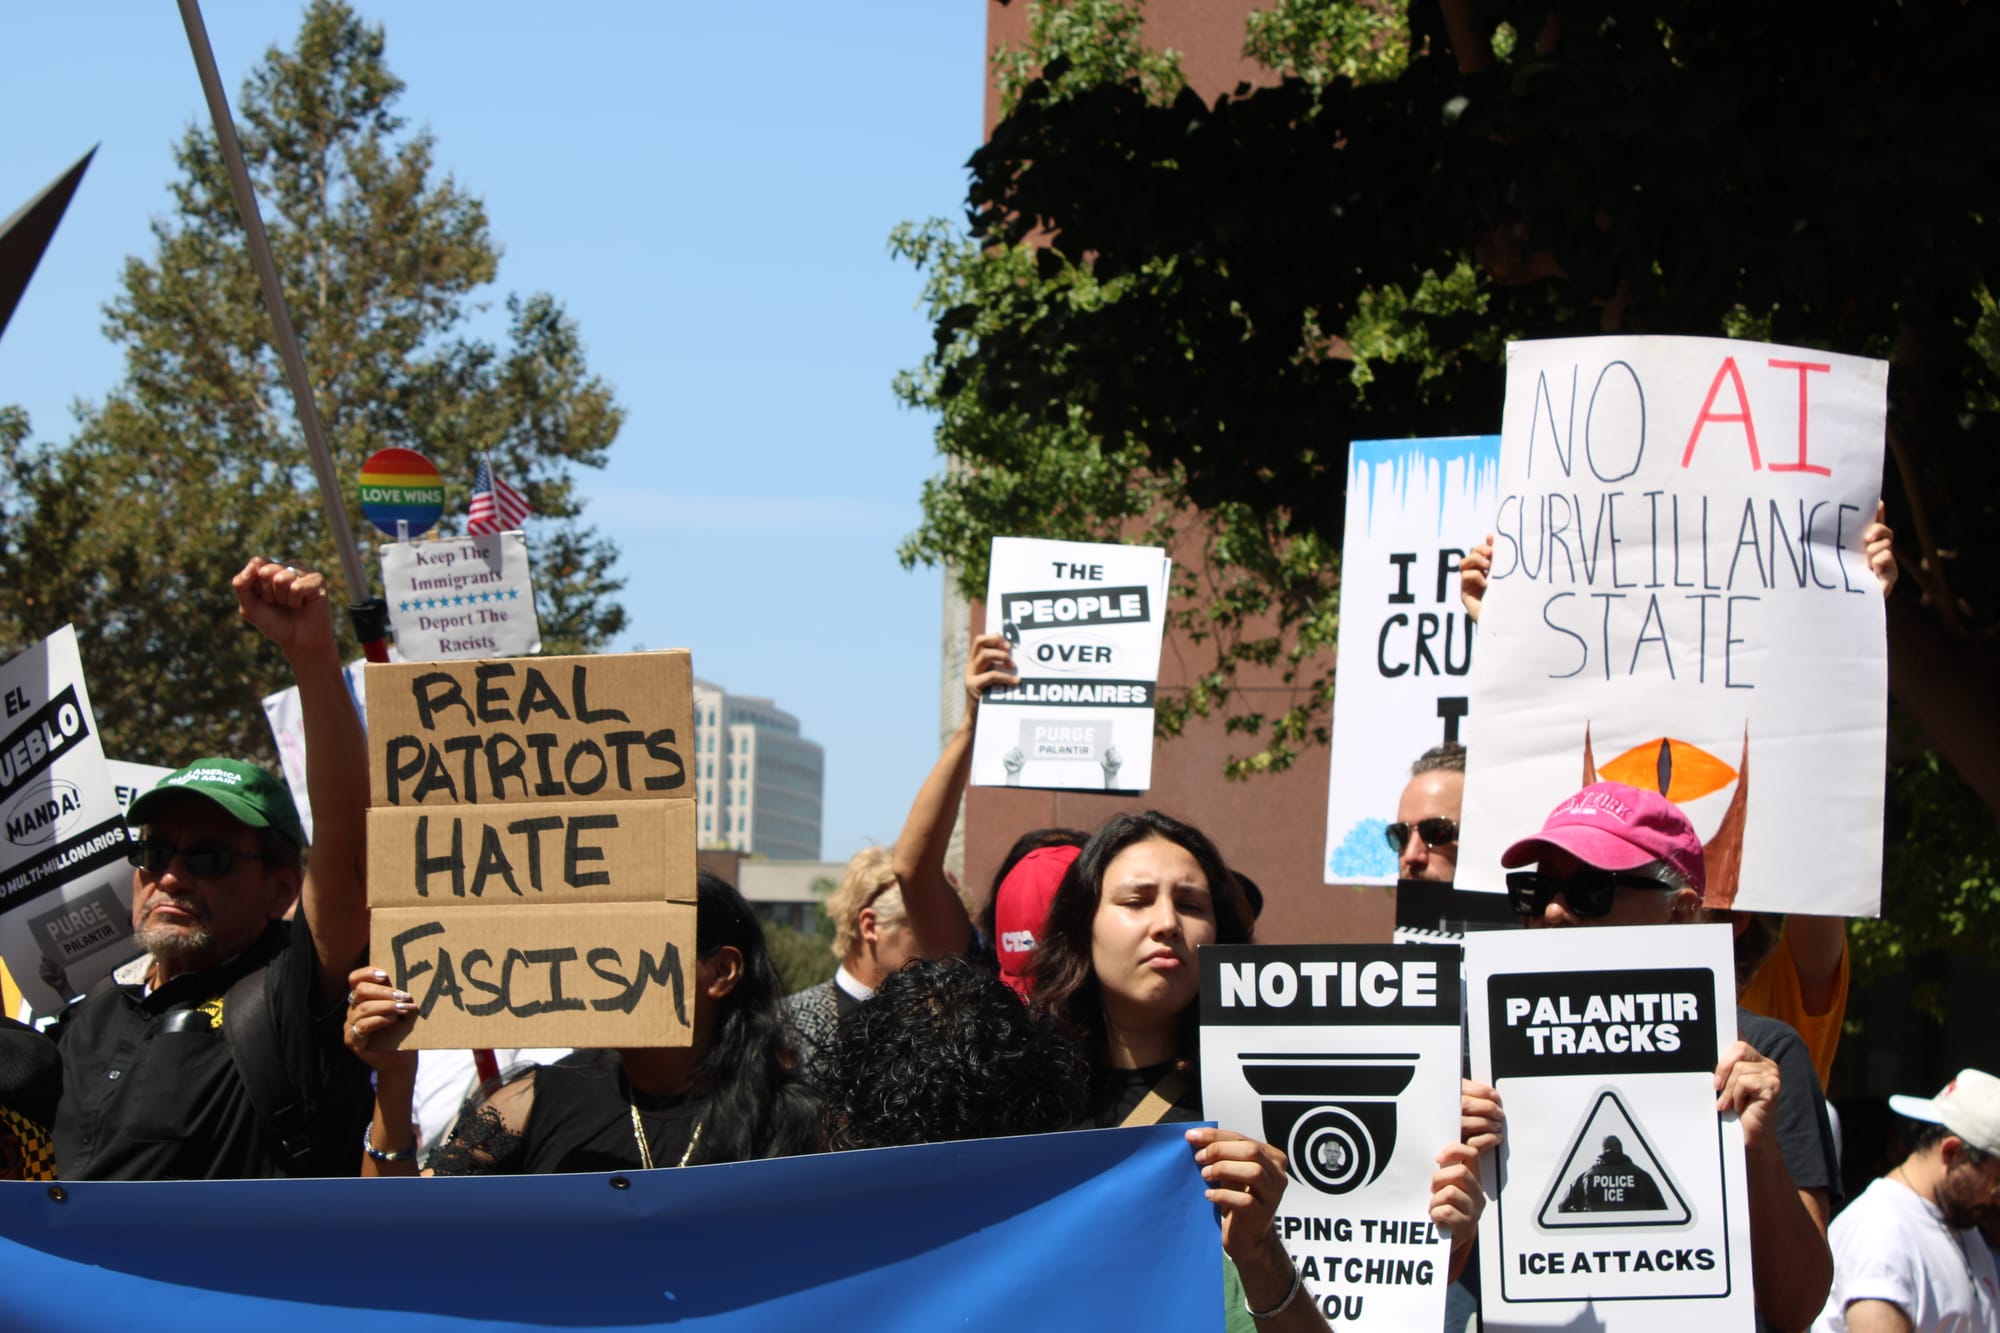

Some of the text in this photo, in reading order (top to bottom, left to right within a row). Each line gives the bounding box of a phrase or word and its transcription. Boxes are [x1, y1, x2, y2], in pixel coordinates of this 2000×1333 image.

[1527, 355, 1832, 482] NO AI
[362, 488, 442, 504] LOVE WINS
[416, 546, 490, 568] Keep The
[1491, 490, 1865, 594] SURVEILLANCE
[410, 569, 503, 591] Immigrants
[1052, 561, 1104, 581] THE
[1388, 548, 1473, 604] I P
[418, 607, 508, 632] Deport The
[1009, 594, 1142, 624] PEOPLE
[438, 635, 496, 654] Racists
[1037, 643, 1113, 664] OVER
[1377, 612, 1478, 679] CRU
[1543, 592, 1761, 689] STATE
[4, 686, 31, 719] EL
[411, 662, 631, 731] REAL
[0, 703, 80, 788] UEBLO
[1034, 725, 1097, 742] PURGE
[1039, 744, 1089, 755] PALANTIR
[192, 767, 243, 782] AMERICA
[385, 727, 687, 805] PATRIOTS
[6, 788, 82, 843] MANDA!
[8, 827, 125, 895] MULTI-MILLONARIOS
[414, 813, 619, 898] HATE
[46, 900, 109, 941] PURGE
[63, 924, 115, 956] PALANTIR
[391, 920, 691, 1029] FASCISM
[1219, 960, 1438, 1008] NOTICE
[1506, 993, 1699, 1026] PALANTIR
[1526, 1024, 1682, 1056] TRACKS
[1593, 1174, 1636, 1188] POLICE
[1603, 1188, 1625, 1202] ICE
[1360, 1219, 1439, 1245] THIEL
[1289, 1255, 1434, 1286] ATCHING
[1519, 1248, 1716, 1276] ICE ATTACKS
[1313, 1294, 1364, 1321] OU
